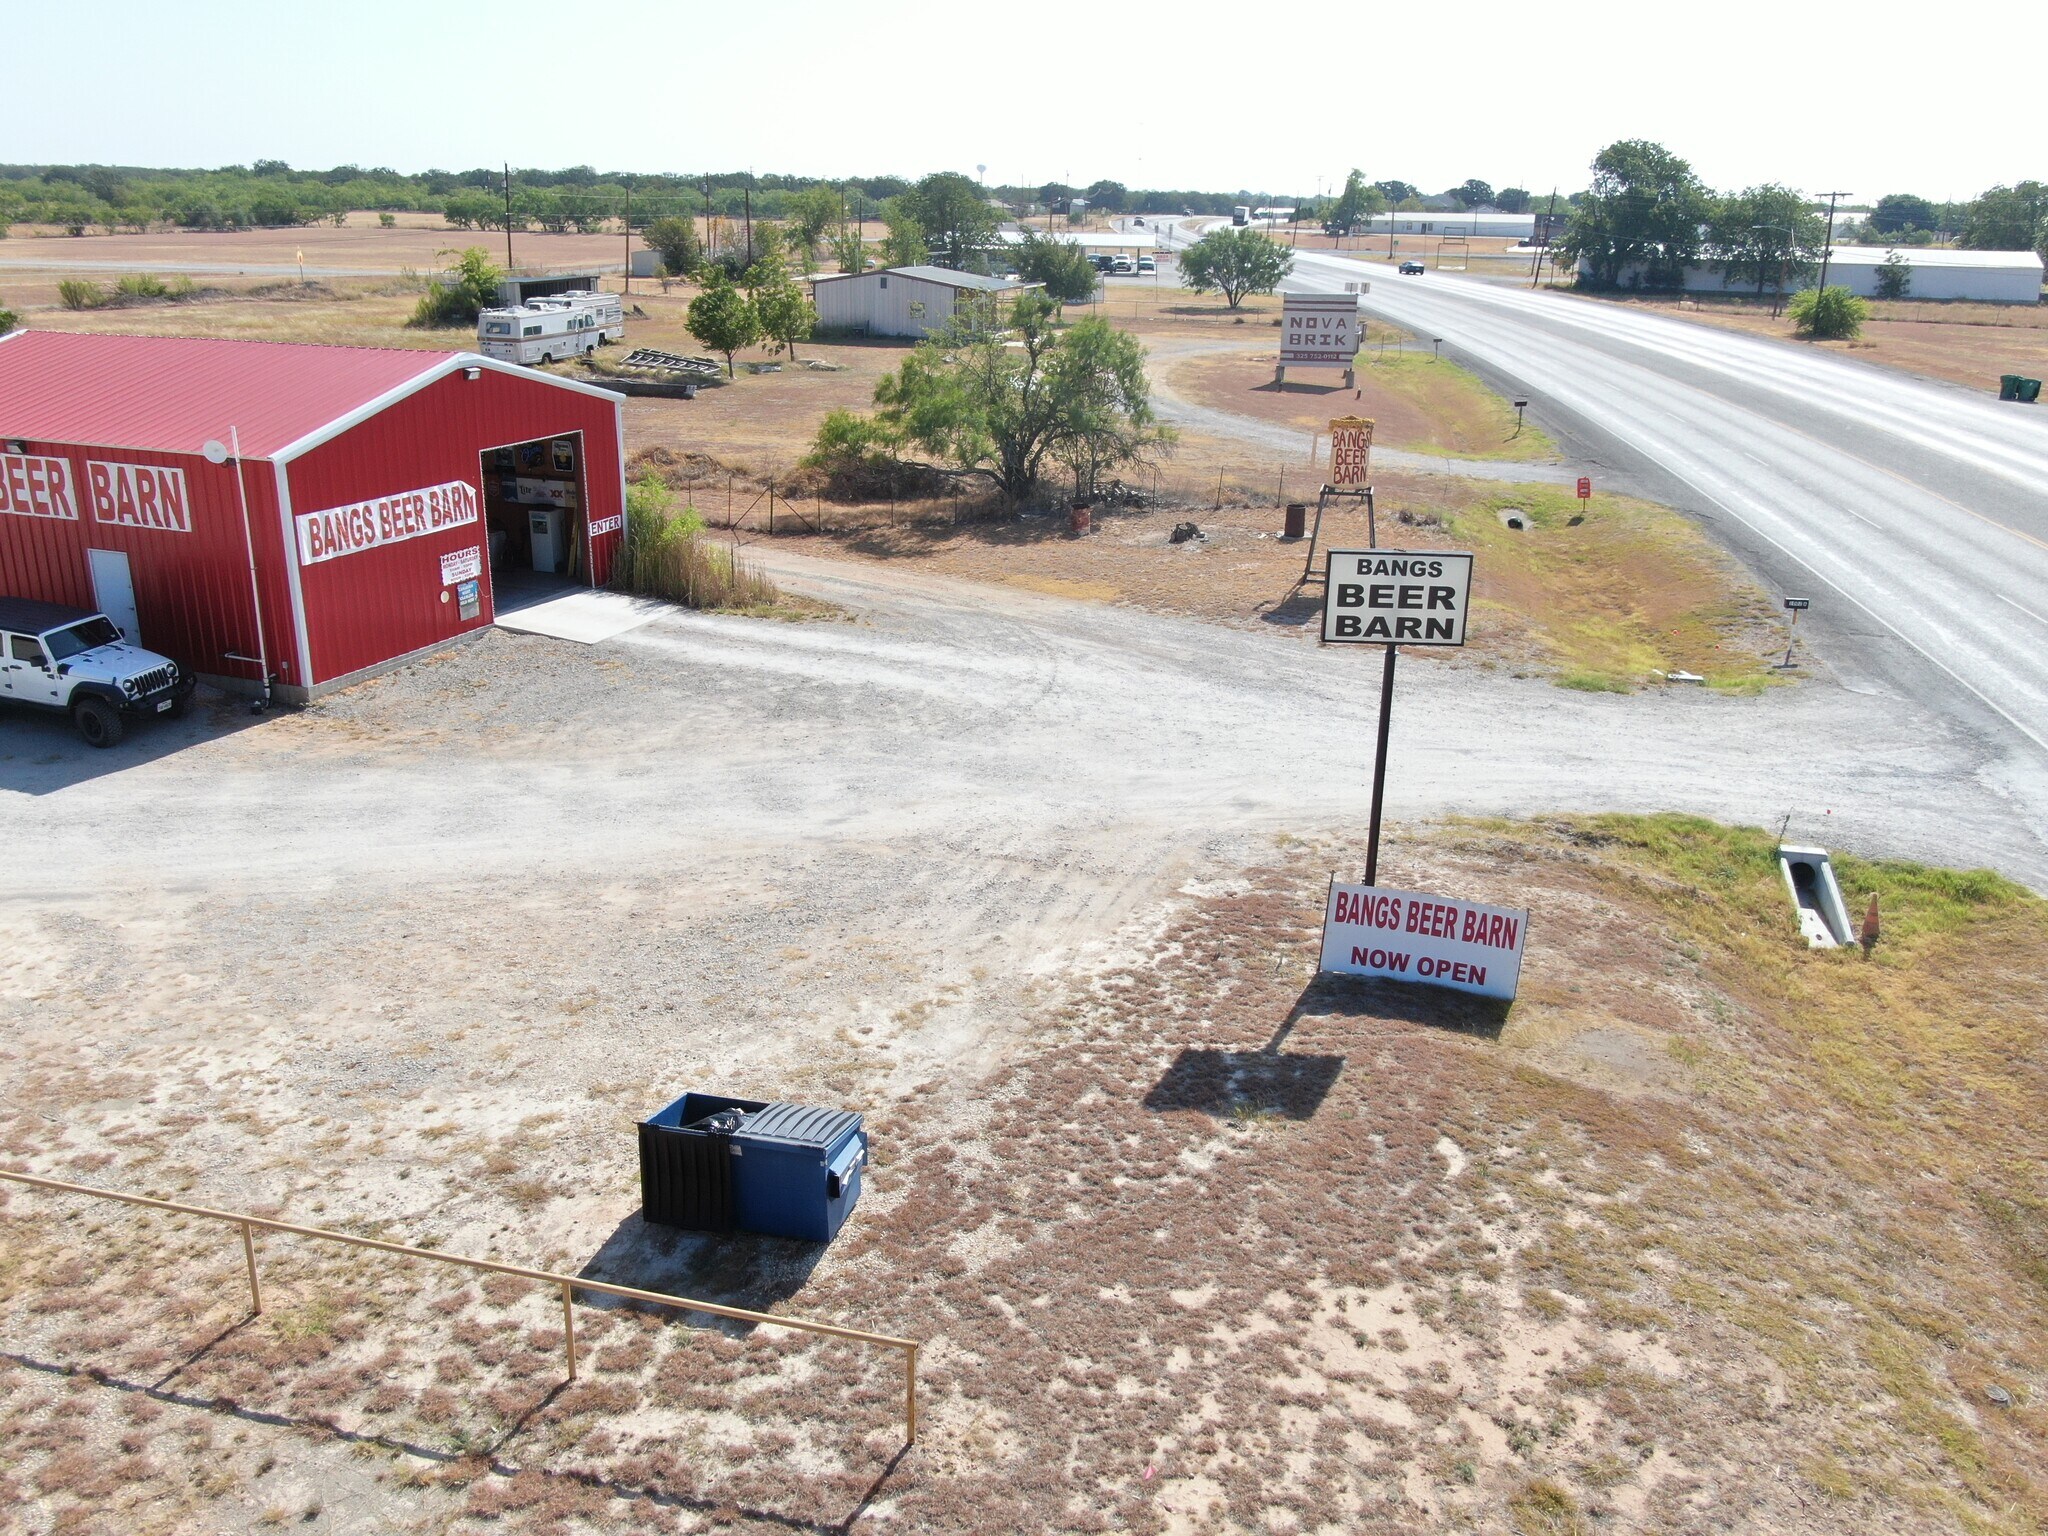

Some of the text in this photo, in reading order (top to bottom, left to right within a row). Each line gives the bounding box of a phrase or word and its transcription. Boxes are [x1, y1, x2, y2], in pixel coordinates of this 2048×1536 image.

[1290, 317, 1347, 329] NOVA
[1289, 334, 1346, 346] BRIK
[1333, 431, 1371, 449] BANGS
[1335, 448, 1367, 465] BEER
[1333, 466, 1367, 484] BARN
[90, 463, 186, 530] BARN
[308, 485, 475, 557] BANGS BEER BARN
[591, 516, 620, 535] ENTER
[442, 547, 478, 564] HOURS
[451, 567, 472, 577] SUNDAY
[1357, 558, 1443, 578] BANGS
[1336, 583, 1456, 611] BEER
[1335, 615, 1455, 640] BARN
[1334, 891, 1519, 951] BANGS BEER BARN
[1351, 946, 1487, 986] NOW OPEN
